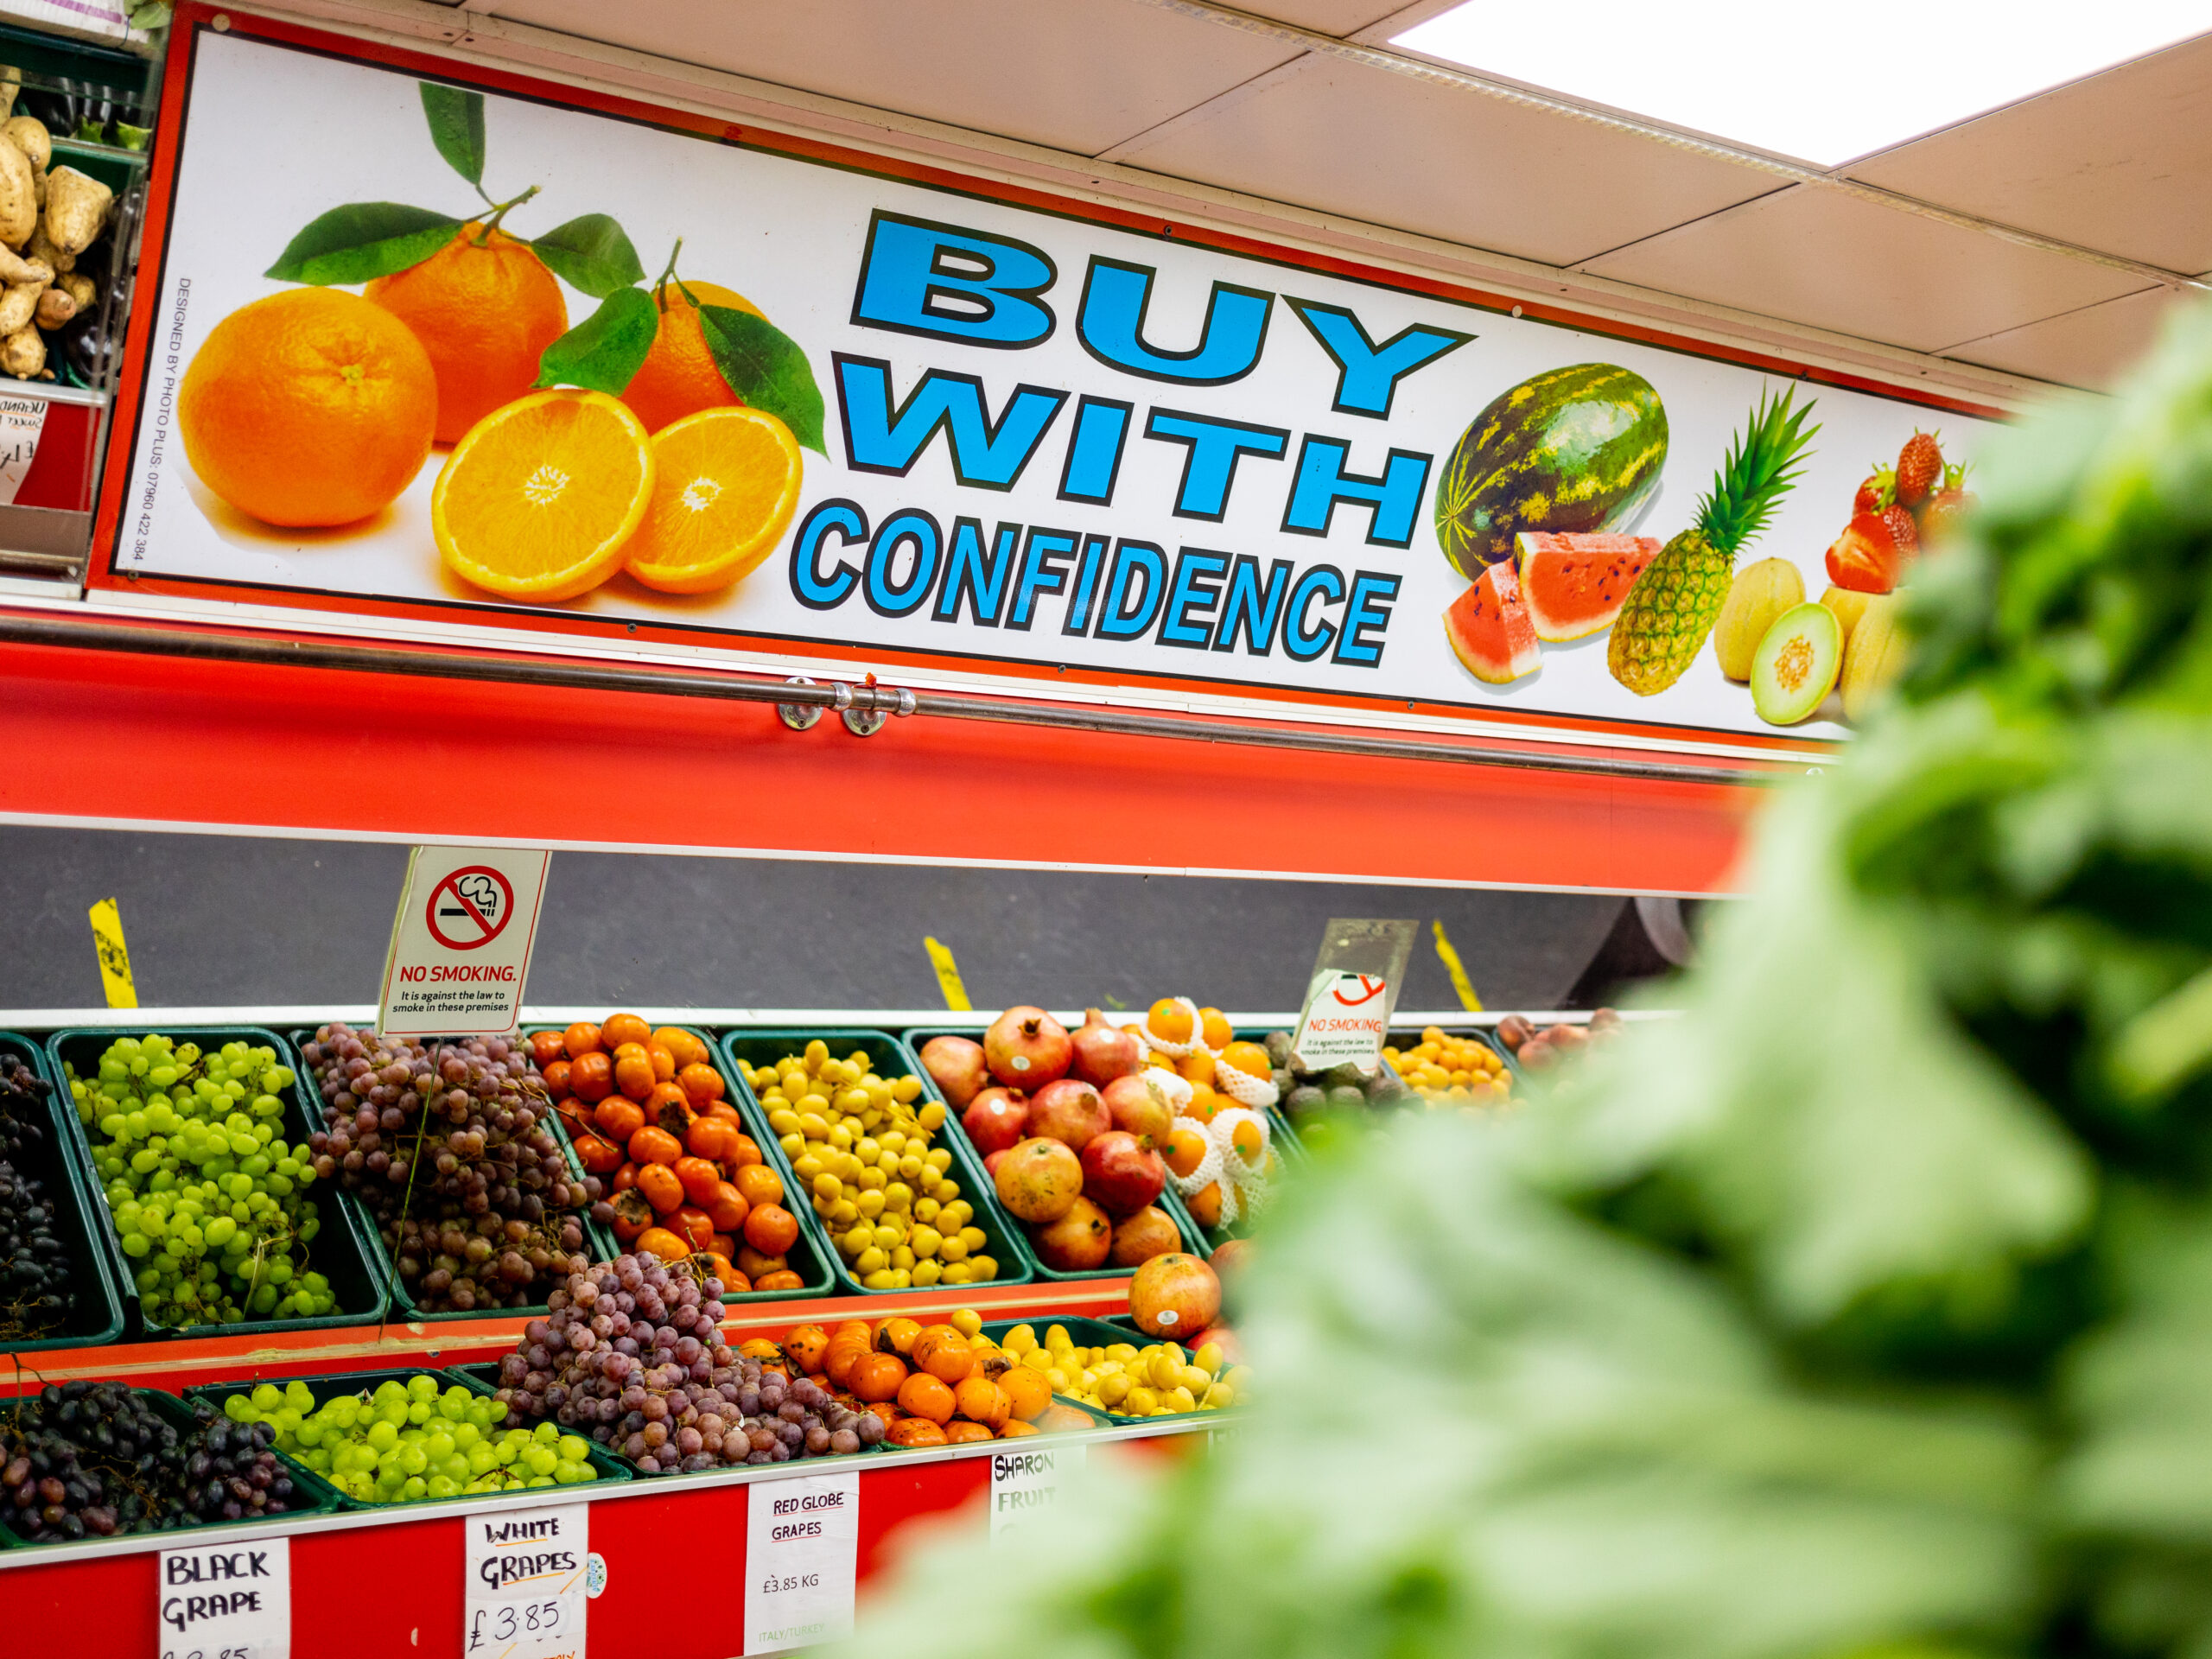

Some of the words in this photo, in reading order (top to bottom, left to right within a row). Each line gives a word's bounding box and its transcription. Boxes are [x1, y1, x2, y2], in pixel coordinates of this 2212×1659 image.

[169, 277, 191, 352] DESIGNED
[849, 208, 1477, 421] BUY
[166, 355, 179, 373] BY
[157, 377, 175, 425] PHOTO
[149, 429, 166, 468] PLUS:
[830, 350, 1434, 550] WITH
[143, 472, 158, 510] 07960
[137, 513, 151, 536] 422
[133, 539, 147, 560] 384
[789, 498, 1403, 668] CONFIDENCE
[400, 965, 427, 982] NO
[429, 965, 517, 982] SMOKING.
[392, 1003, 424, 1012] smoke
[426, 1003, 435, 1012] in
[438, 1002, 464, 1012] these
[466, 1002, 509, 1014] premises
[402, 991, 410, 1000] It
[411, 991, 419, 1000] is
[422, 991, 456, 1002] against
[459, 990, 474, 1000] the
[477, 990, 493, 1000] law
[495, 991, 505, 1000] to
[1308, 1018, 1326, 1032] NO
[1319, 1039, 1343, 1047] against
[995, 1452, 1054, 1482] SHARON
[773, 1497, 799, 1515] RED
[802, 1492, 844, 1510] GLOBE
[998, 1486, 1056, 1512] FRUIT
[485, 1517, 560, 1543] WHITE
[772, 1522, 822, 1541] GRAPES
[167, 1551, 270, 1586] BLACK
[480, 1551, 576, 1590] GRAPES
[763, 1575, 798, 1593] £3.85
[802, 1573, 819, 1587] KG
[162, 1591, 262, 1632] GRAPE
[759, 1623, 825, 1643] ITALY/TURKEY
